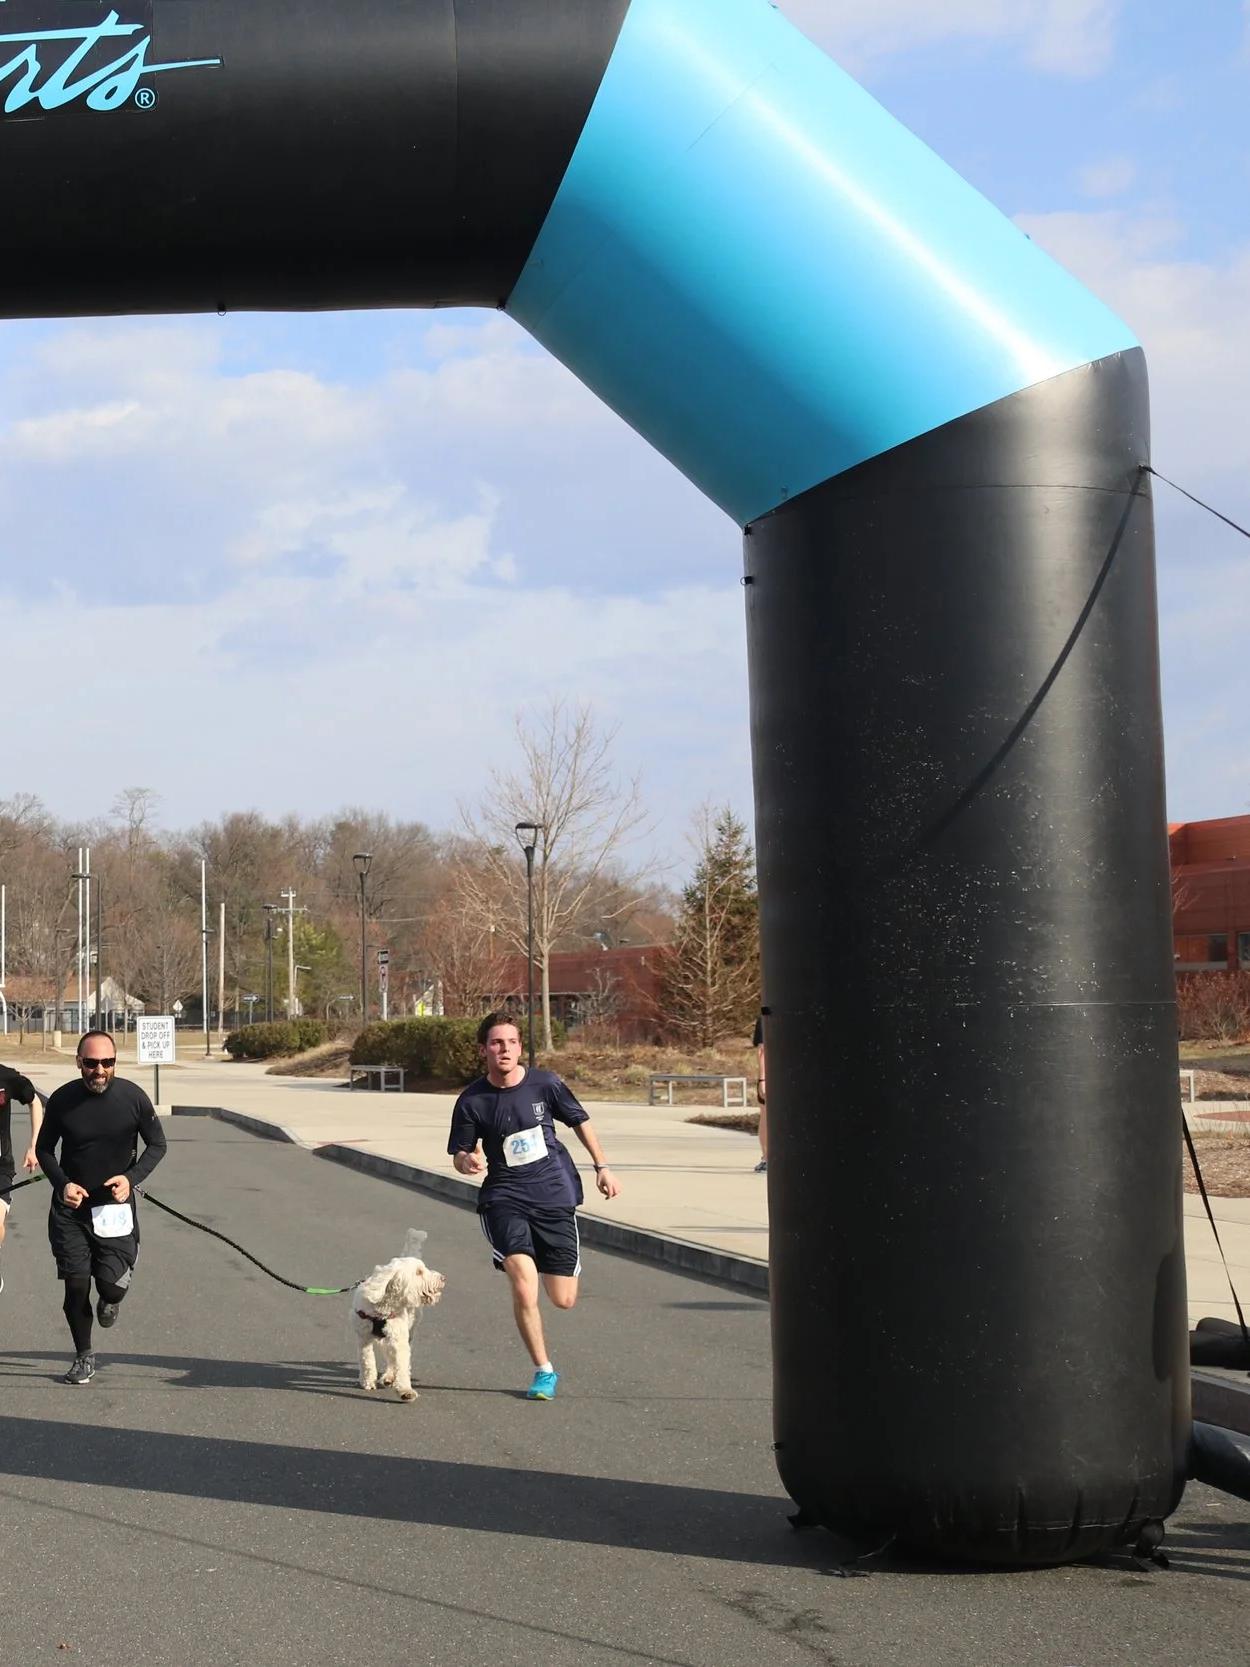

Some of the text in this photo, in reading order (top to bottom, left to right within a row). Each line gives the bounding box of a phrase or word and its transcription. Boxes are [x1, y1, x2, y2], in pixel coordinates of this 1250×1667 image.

[141, 1021, 169, 1031] STUDENT
[141, 1031, 171, 1040] DROP OFF
[141, 1040, 171, 1050] & PICK UP
[148, 1050, 164, 1059] HERE
